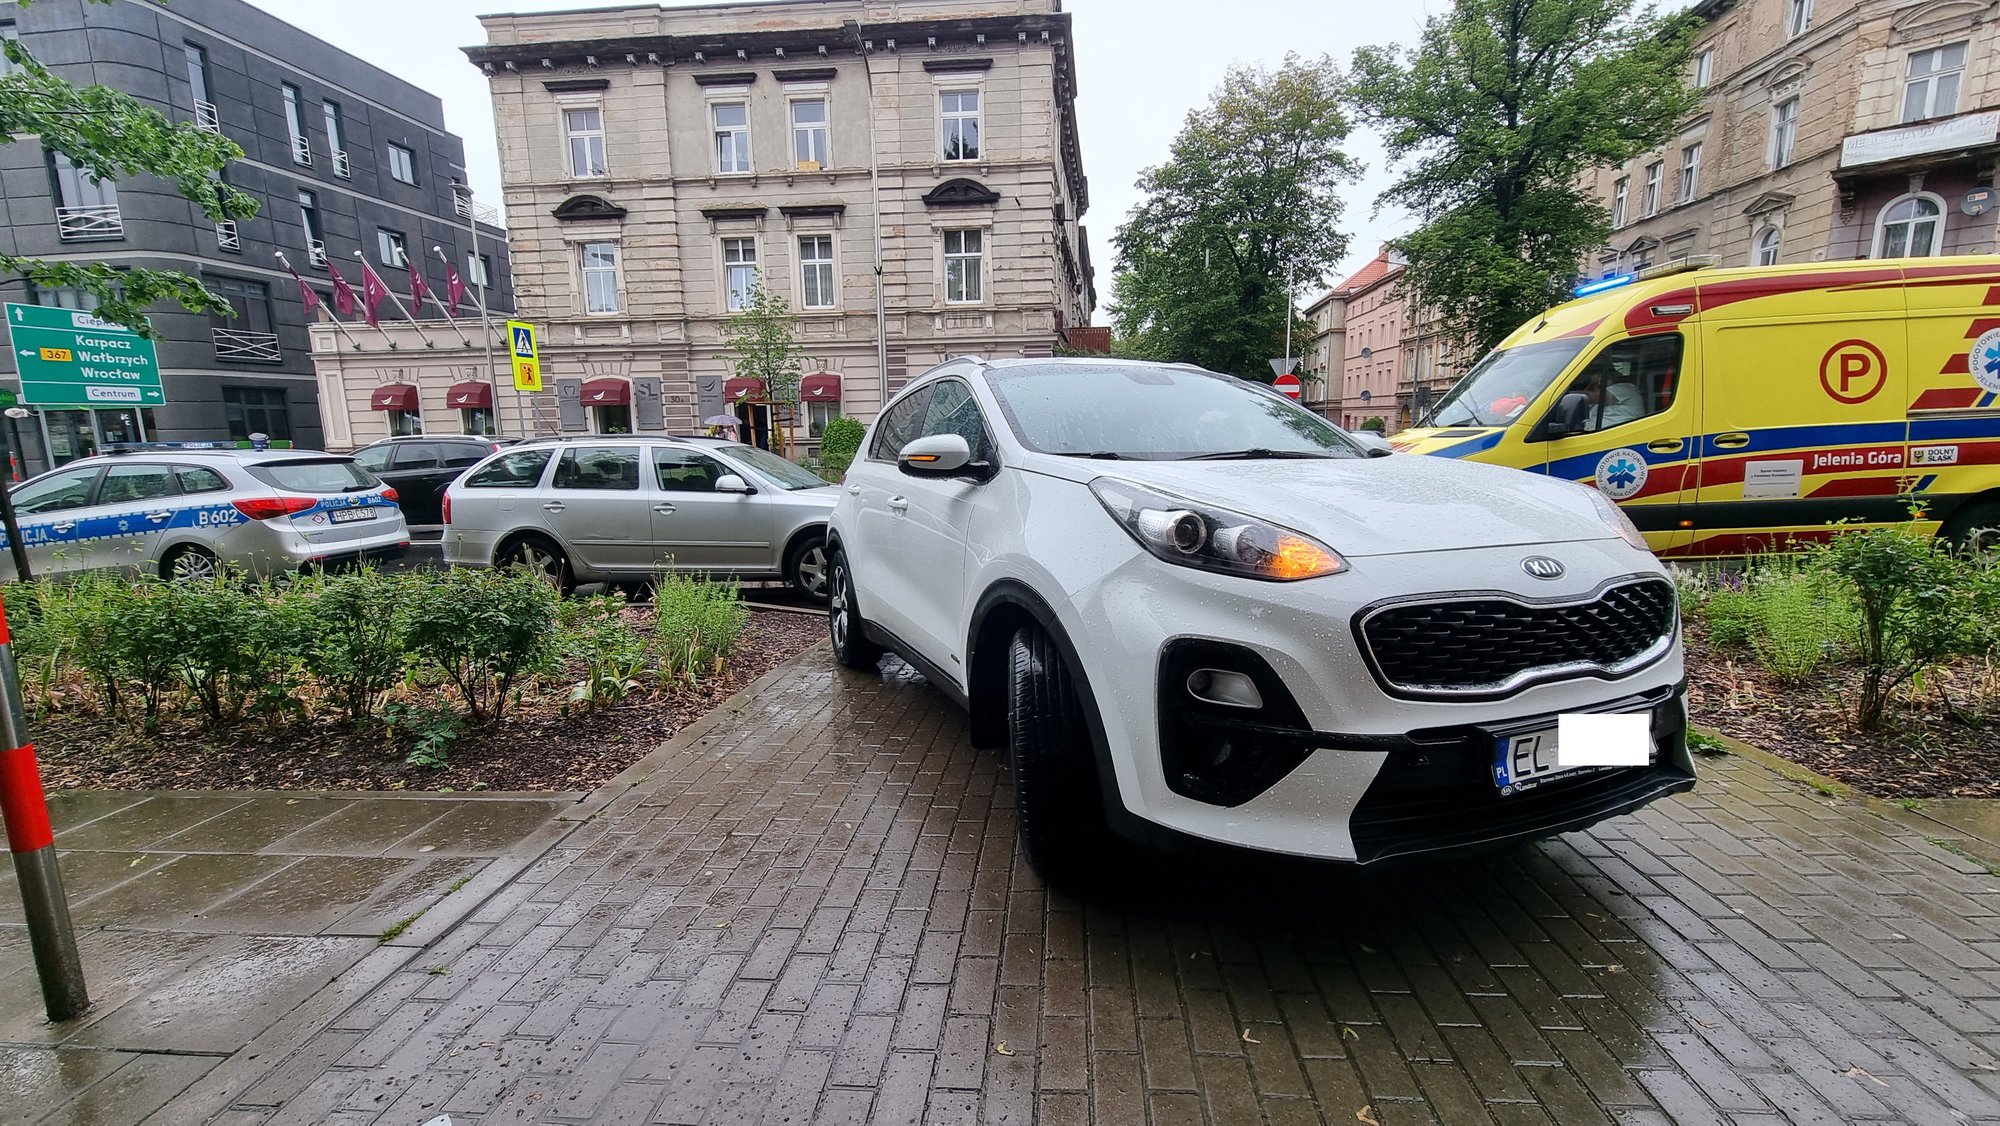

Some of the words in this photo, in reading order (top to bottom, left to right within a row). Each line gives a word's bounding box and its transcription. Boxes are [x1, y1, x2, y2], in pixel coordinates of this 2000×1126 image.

[75, 334, 131, 350] Karpacz
[47, 350, 67, 359] 367
[77, 350, 148, 367] Wałbrzych
[80, 366, 141, 380] Wrocław
[1840, 353, 1872, 392] P
[92, 388, 136, 398] Centrum
[1928, 448, 1954, 456] DOLNY
[1812, 451, 1864, 469] Jelenia
[1868, 450, 1902, 464] Góra
[320, 500, 347, 508] POLICJA
[0, 528, 48, 545] PICJA
[1527, 560, 1562, 574] KIA
[1514, 735, 1549, 778] EL
[1496, 766, 1507, 779] PL
